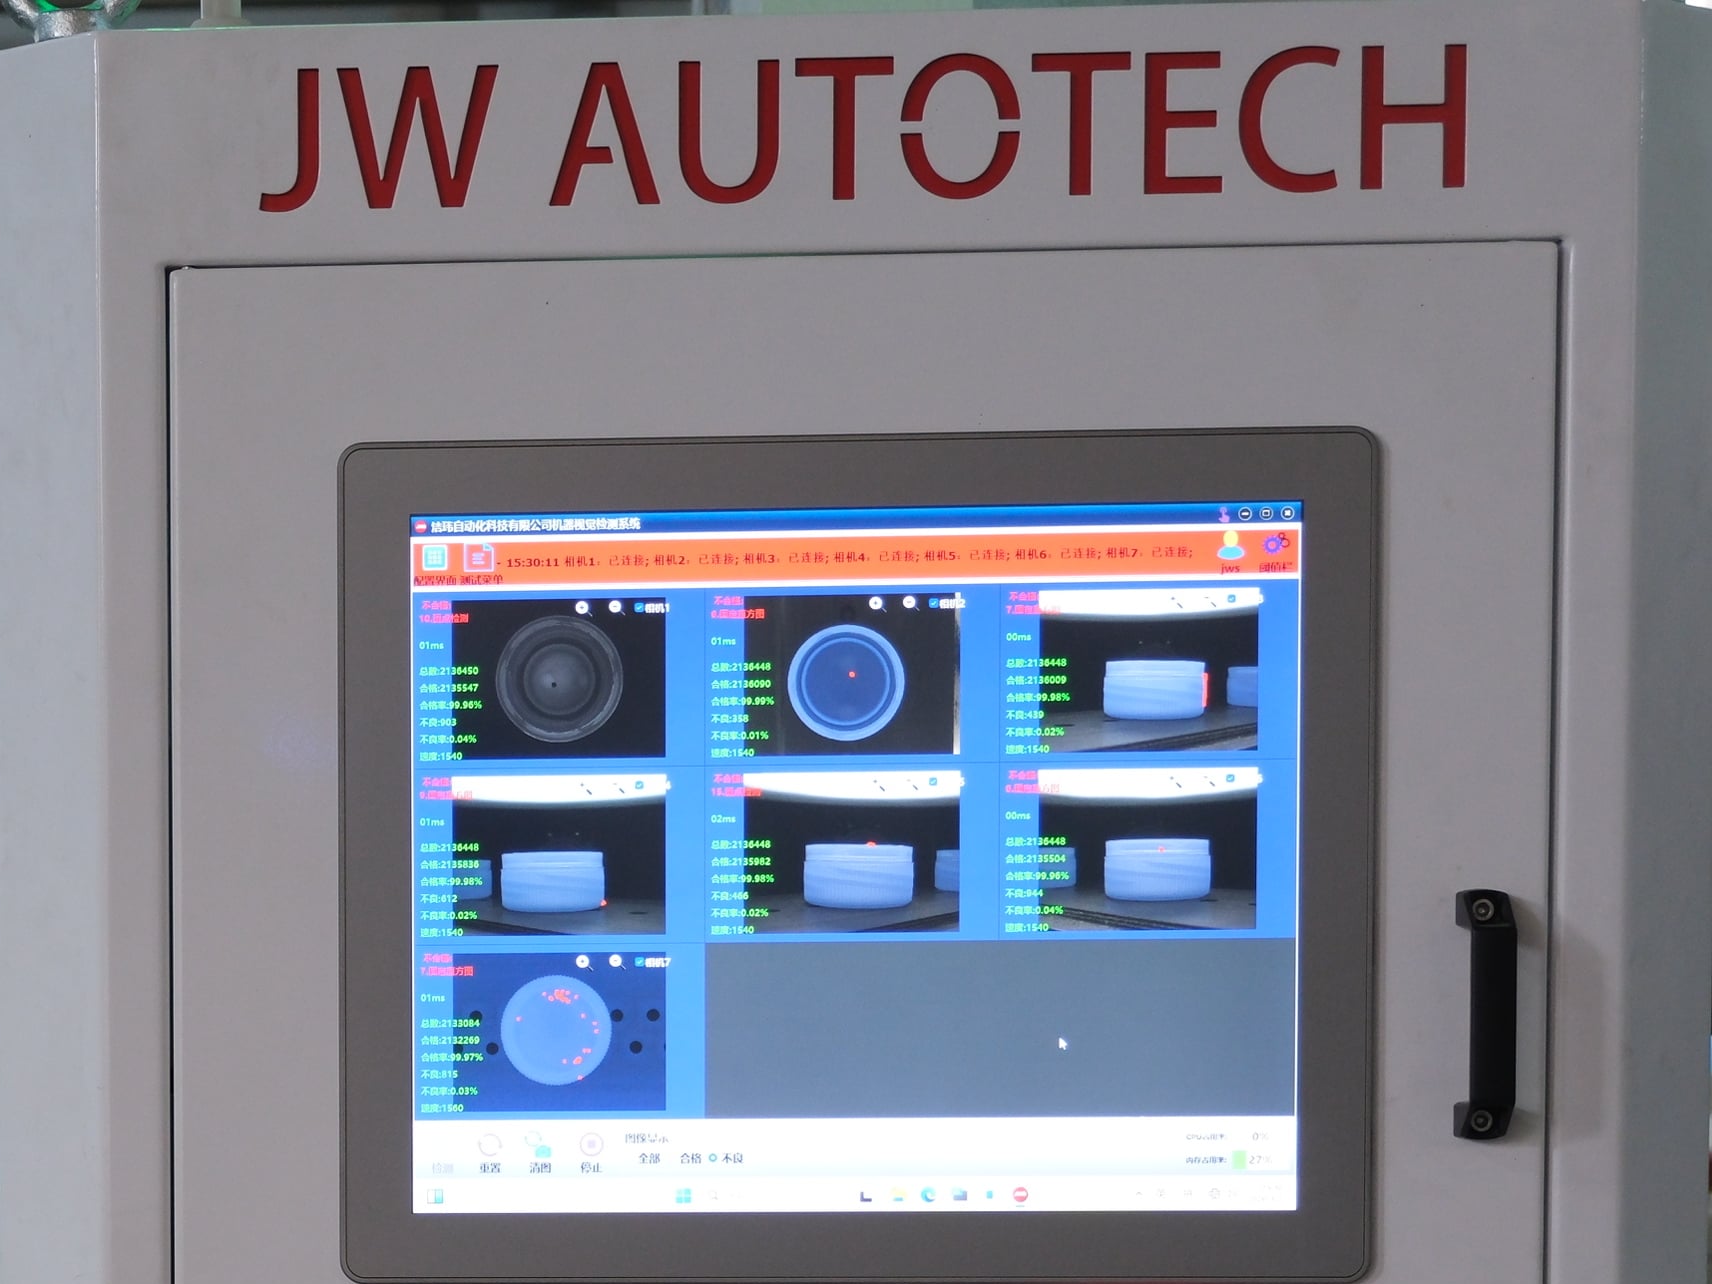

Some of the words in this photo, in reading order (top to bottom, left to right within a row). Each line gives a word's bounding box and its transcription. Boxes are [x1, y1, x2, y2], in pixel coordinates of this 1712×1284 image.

[260, 63, 500, 213] JW
[548, 43, 1467, 206] AUTOTECH
[506, 558, 559, 568] 15:30:11
[1221, 563, 1240, 574] jws
[711, 637, 736, 646] 01ms
[1006, 633, 1031, 641] 00ms
[419, 641, 444, 650] 01ms
[419, 667, 479, 676] 总数:2136450
[419, 684, 479, 693] 合格:2135547
[419, 718, 456, 727] 不良:903
[419, 735, 477, 744] 不良率:0.04%
[711, 815, 736, 823] 02ms
[1005, 812, 1030, 820] 00ms
[420, 818, 444, 826] 01ms
[421, 994, 445, 1002] 01ms
[638, 1153, 661, 1164] 全部
[680, 1153, 702, 1164] 合格
[722, 1152, 744, 1164] 不良
[580, 1163, 603, 1174] 停止
